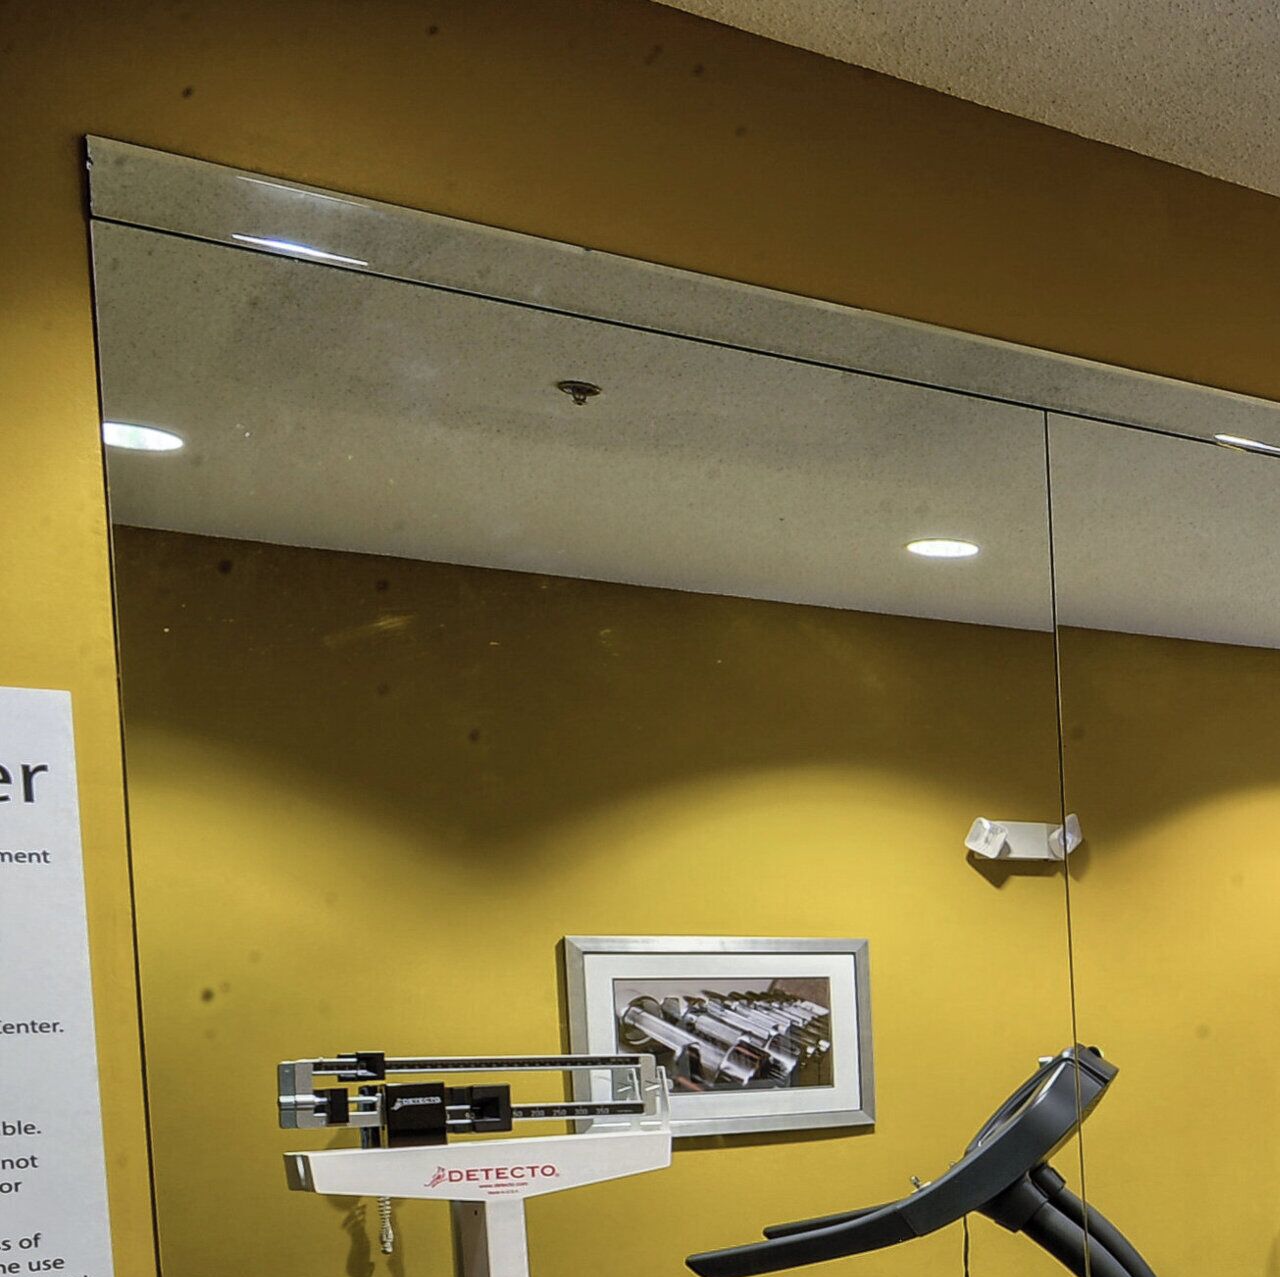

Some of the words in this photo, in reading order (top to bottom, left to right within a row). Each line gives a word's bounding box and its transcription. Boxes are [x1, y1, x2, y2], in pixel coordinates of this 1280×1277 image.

[0, 1120, 42, 1136] ble.
[1, 1155, 39, 1170] not
[448, 1165, 556, 1182] DETECTO
[0, 1238, 12, 1251] s
[18, 1232, 42, 1249] of
[28, 1258, 65, 1272] use
